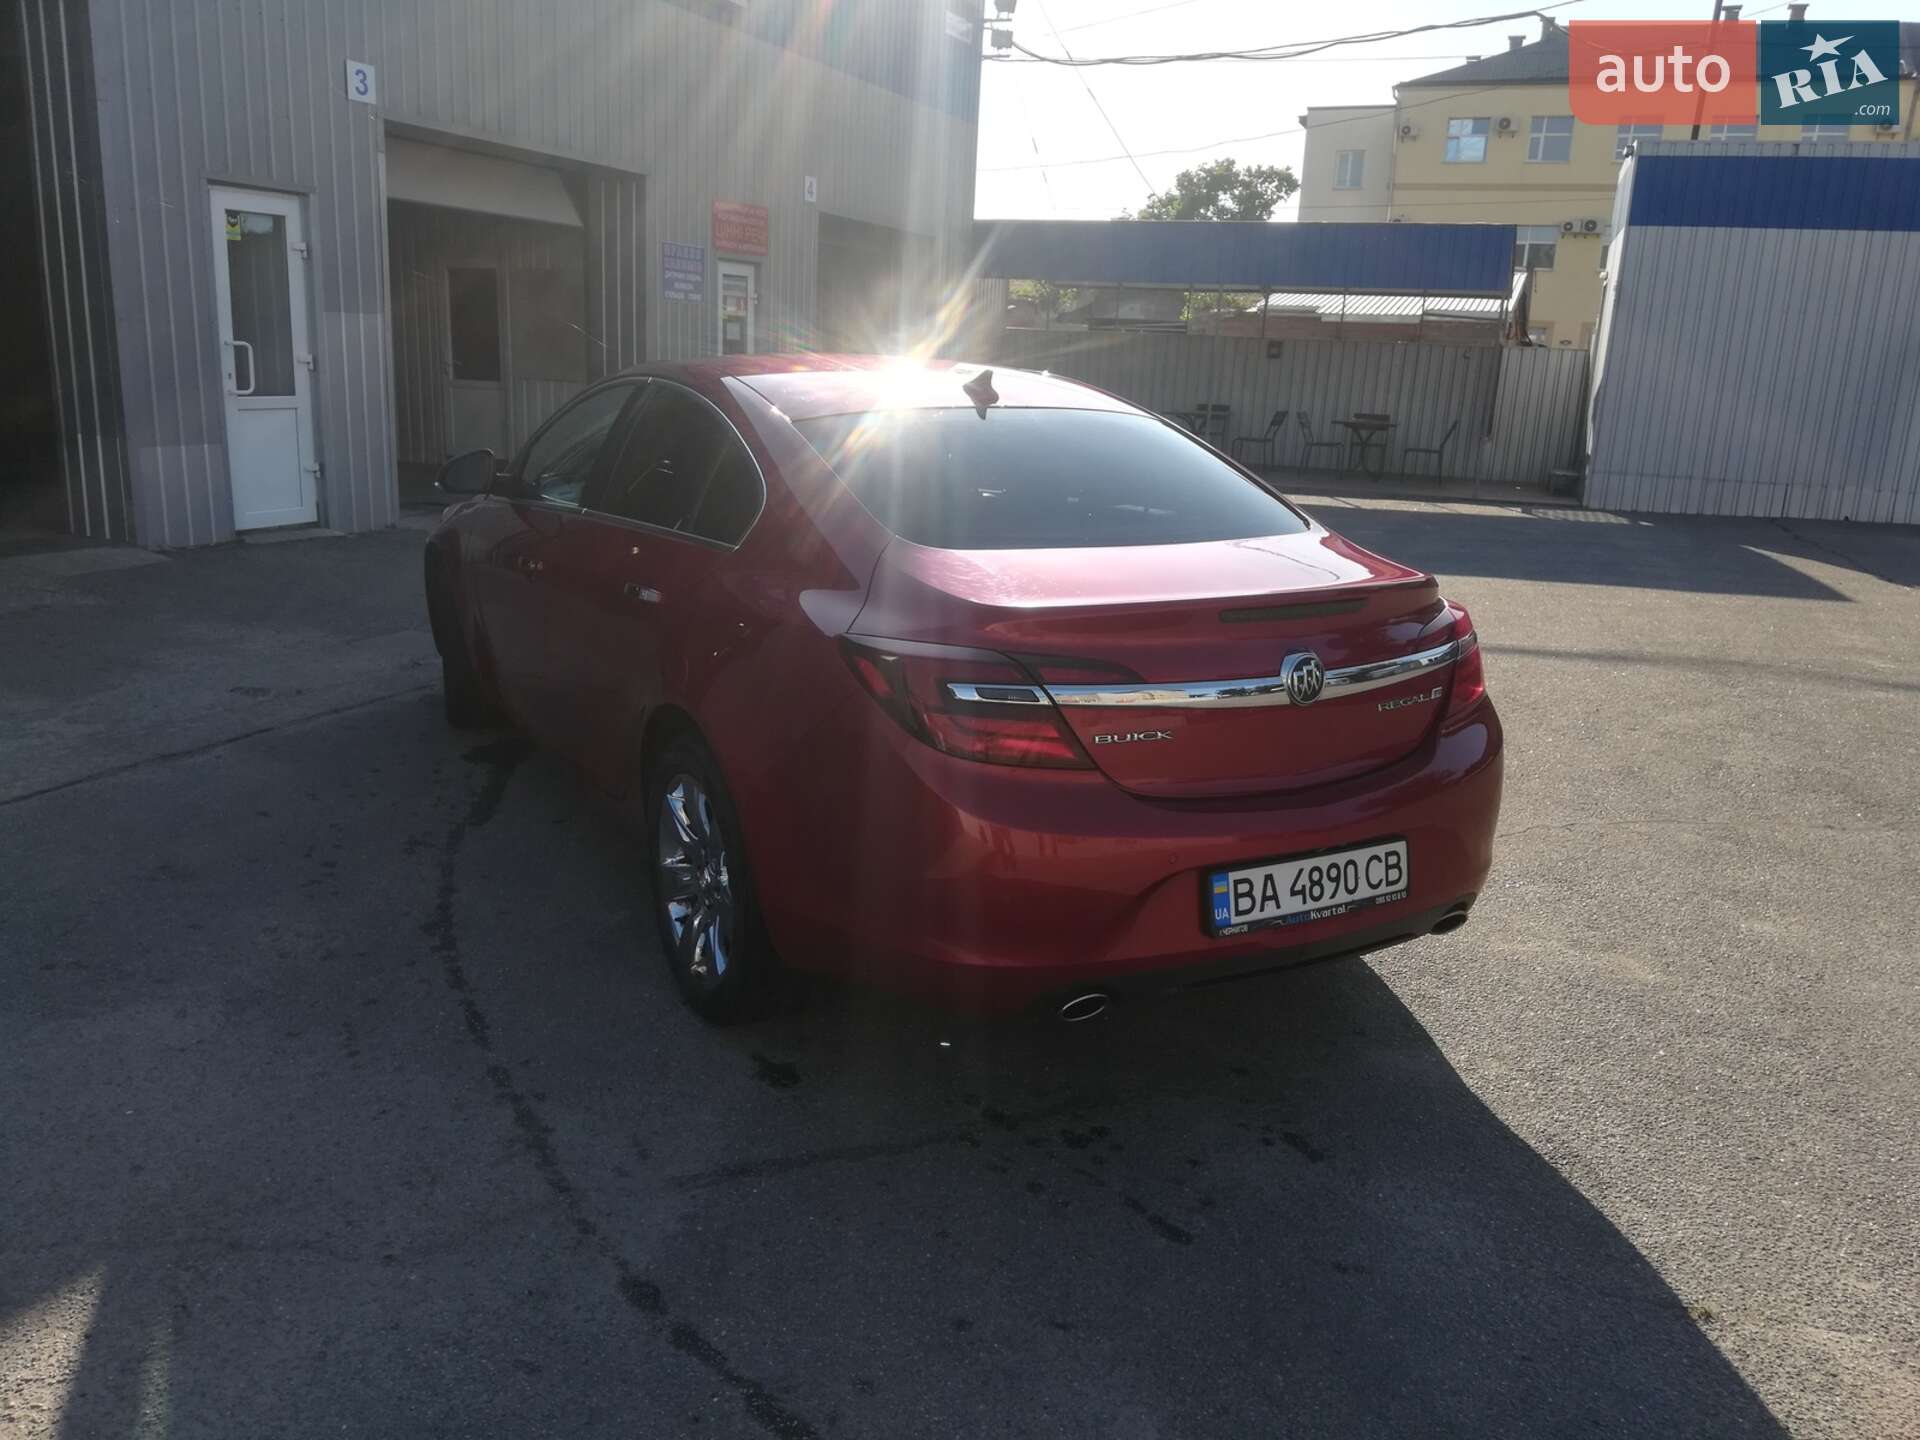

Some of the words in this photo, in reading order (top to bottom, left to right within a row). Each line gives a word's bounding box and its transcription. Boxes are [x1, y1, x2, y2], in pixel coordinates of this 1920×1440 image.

[355, 69, 369, 96] 3
[1377, 693, 1430, 713] REGAL
[1094, 731, 1174, 744] BUICK
[1233, 874, 1281, 917] BA
[1290, 858, 1359, 905] 4890
[1365, 850, 1403, 890] CB
[1215, 908, 1230, 920] UA
